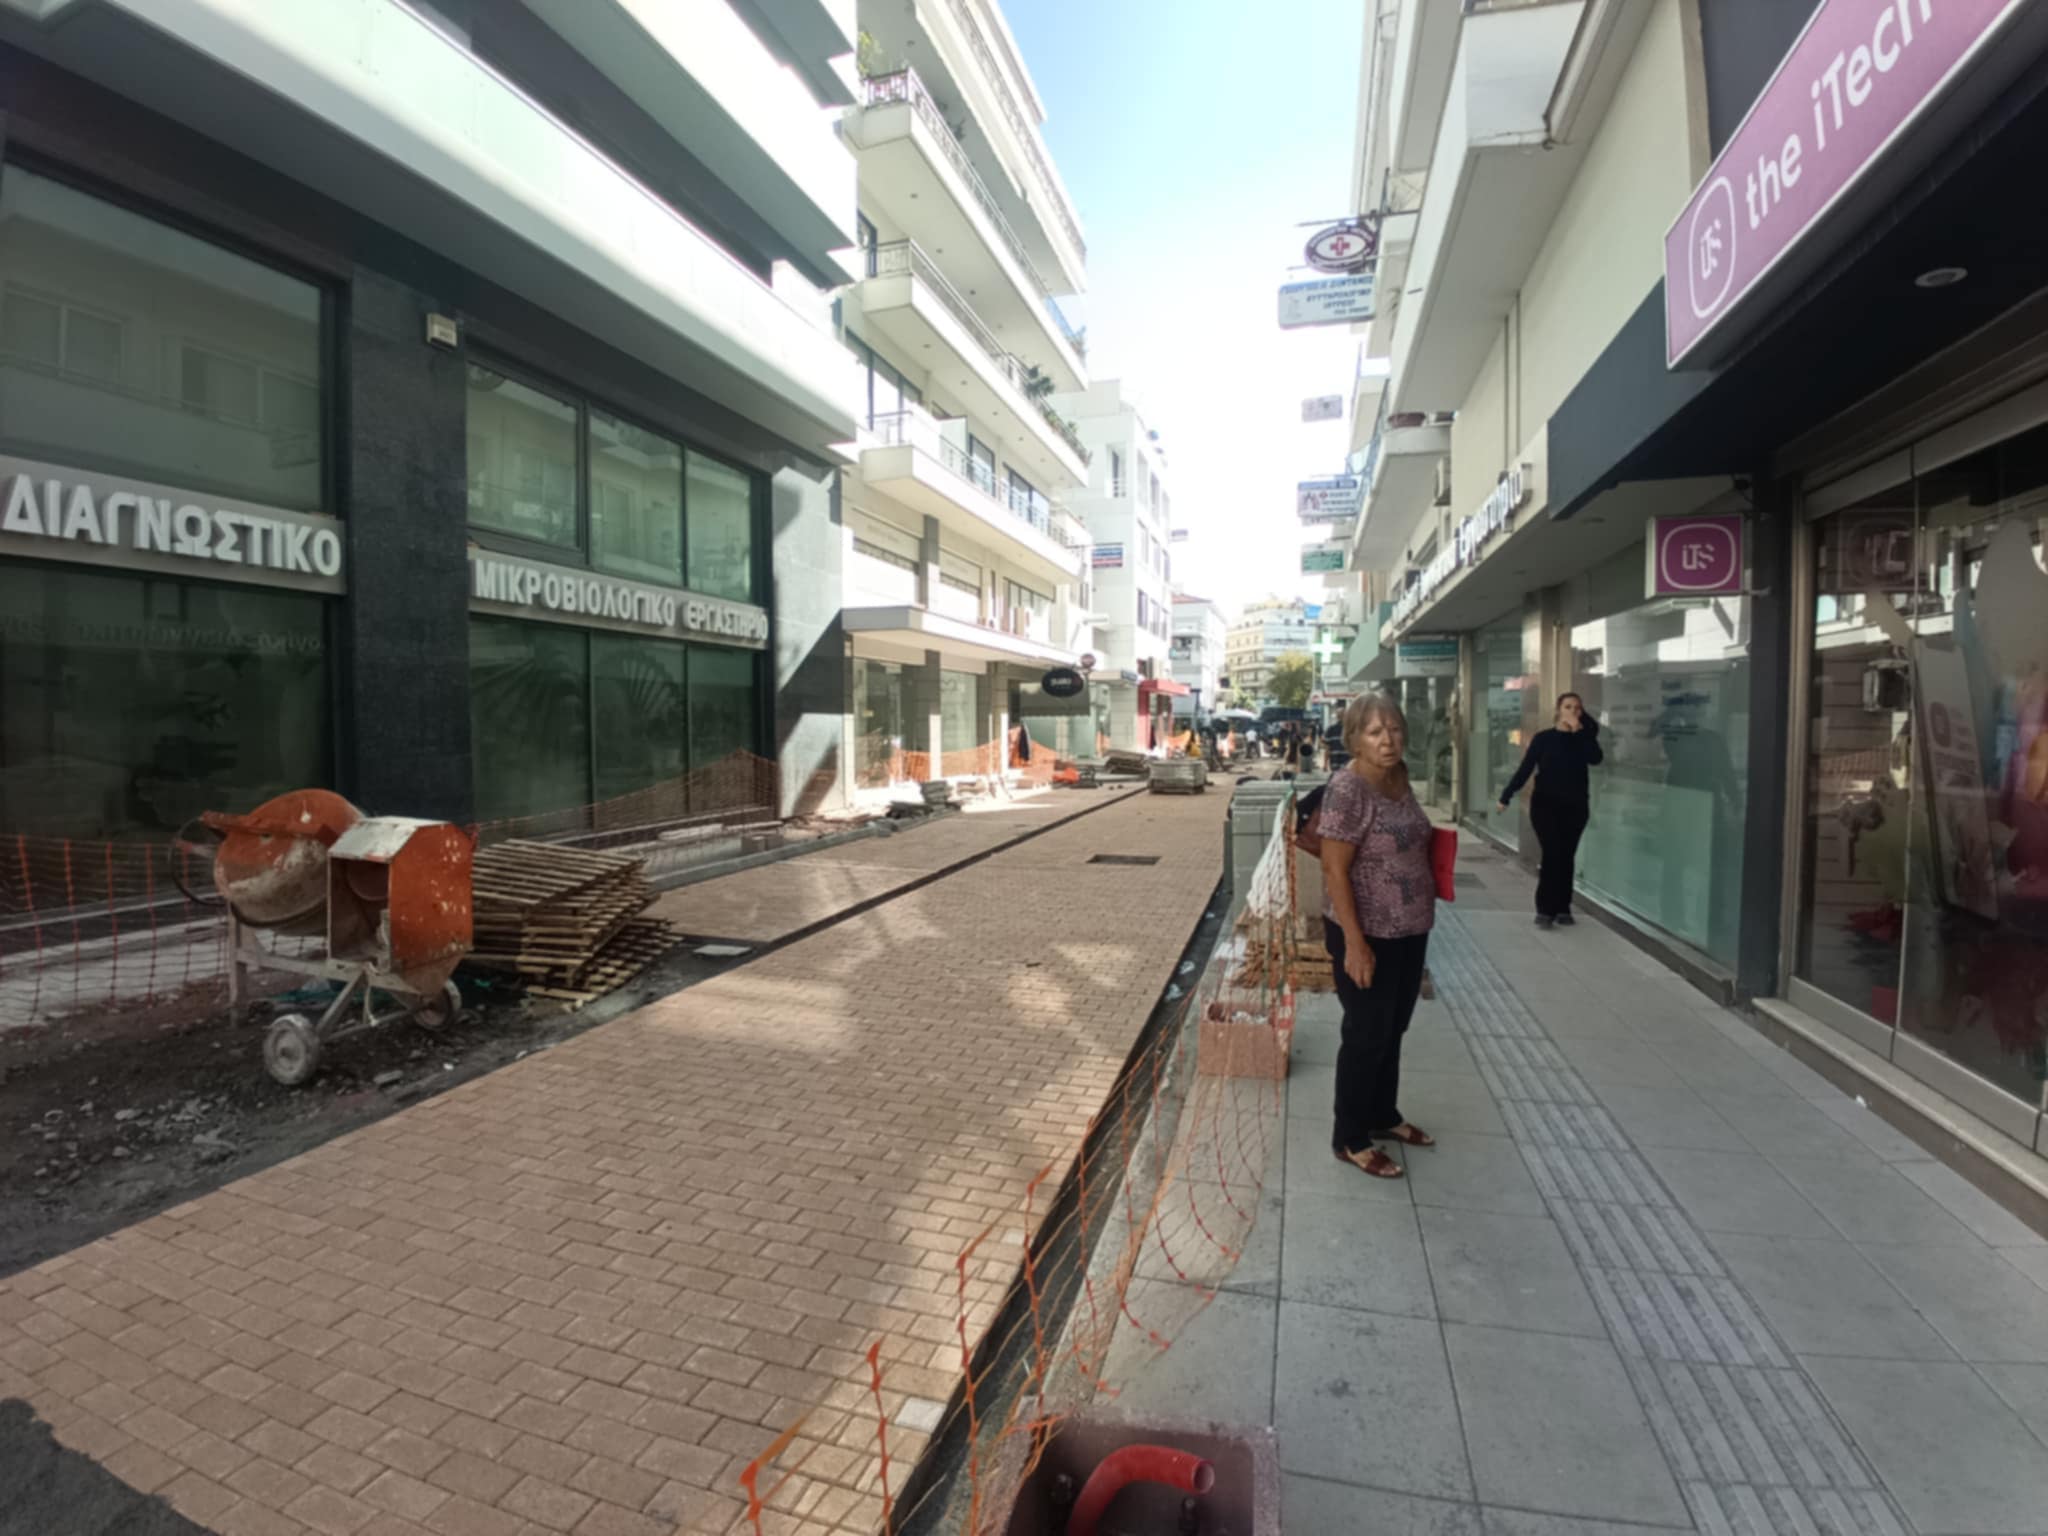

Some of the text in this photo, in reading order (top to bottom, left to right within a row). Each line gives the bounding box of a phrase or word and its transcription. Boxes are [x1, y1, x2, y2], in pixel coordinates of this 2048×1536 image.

[1745, 133, 1802, 230] the
[2, 473, 342, 577] ΔΙΑΓΝΩΣΤΙΚΟ
[475, 559, 769, 641] ΜΙΚΡΟΒΙΟΛΟΓΙΚΟ ΕΡΓΑΣΤΗΡΙΟ
